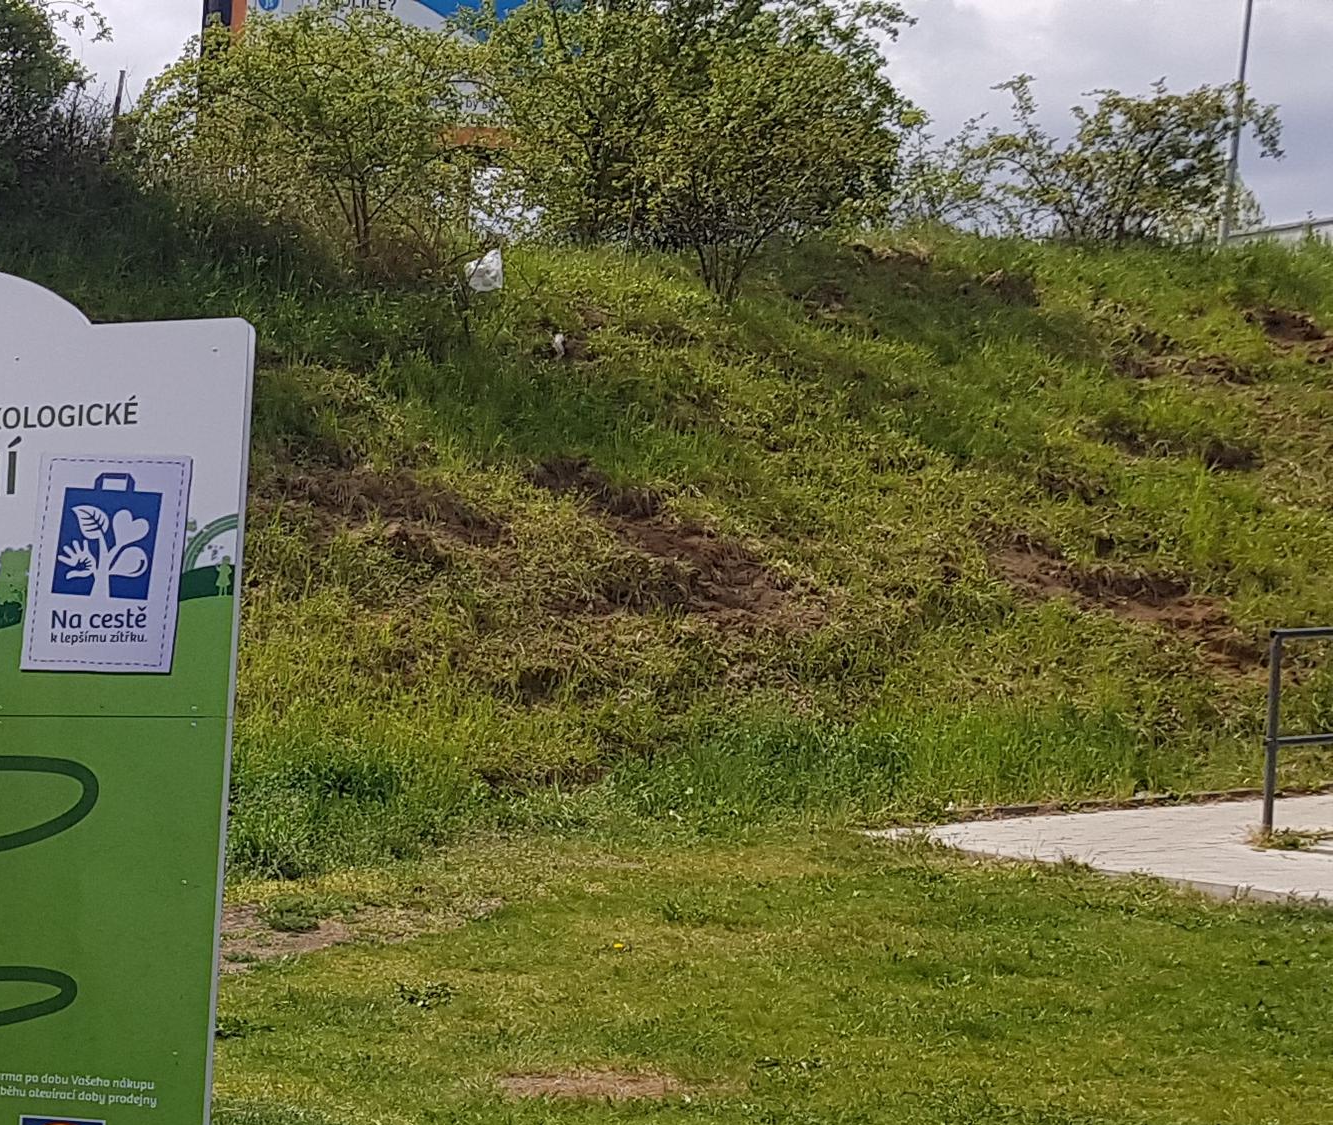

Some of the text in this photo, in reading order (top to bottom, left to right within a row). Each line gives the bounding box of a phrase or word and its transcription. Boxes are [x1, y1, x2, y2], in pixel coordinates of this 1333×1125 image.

[51, 605, 147, 629] Na cestě
[50, 632, 58, 643] k
[60, 630, 107, 646] lepšímu
[25, 1074, 39, 1085] po
[41, 1073, 69, 1085] dobu
[71, 1075, 110, 1087] Vašeho
[113, 1077, 155, 1092] nákupu
[28, 1087, 76, 1100] otevírací
[78, 1091, 106, 1105] doby
[108, 1093, 158, 1109] prodejny
